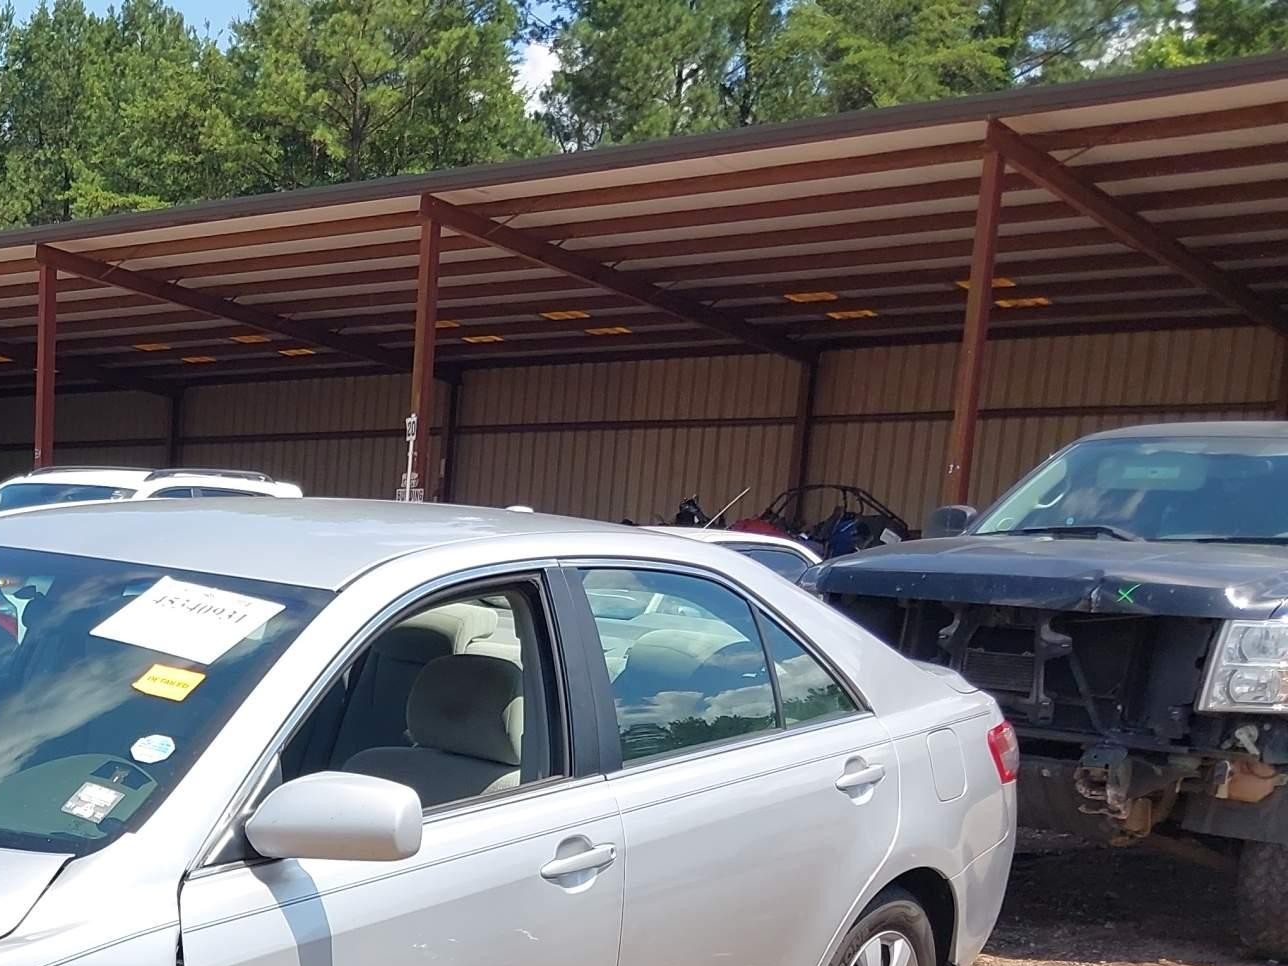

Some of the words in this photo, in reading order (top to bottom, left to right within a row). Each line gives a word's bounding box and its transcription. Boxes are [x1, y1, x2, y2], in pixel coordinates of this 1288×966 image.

[407, 420, 416, 436] 20
[152, 594, 248, 624] 45340931
[146, 675, 190, 690] DETAILED
